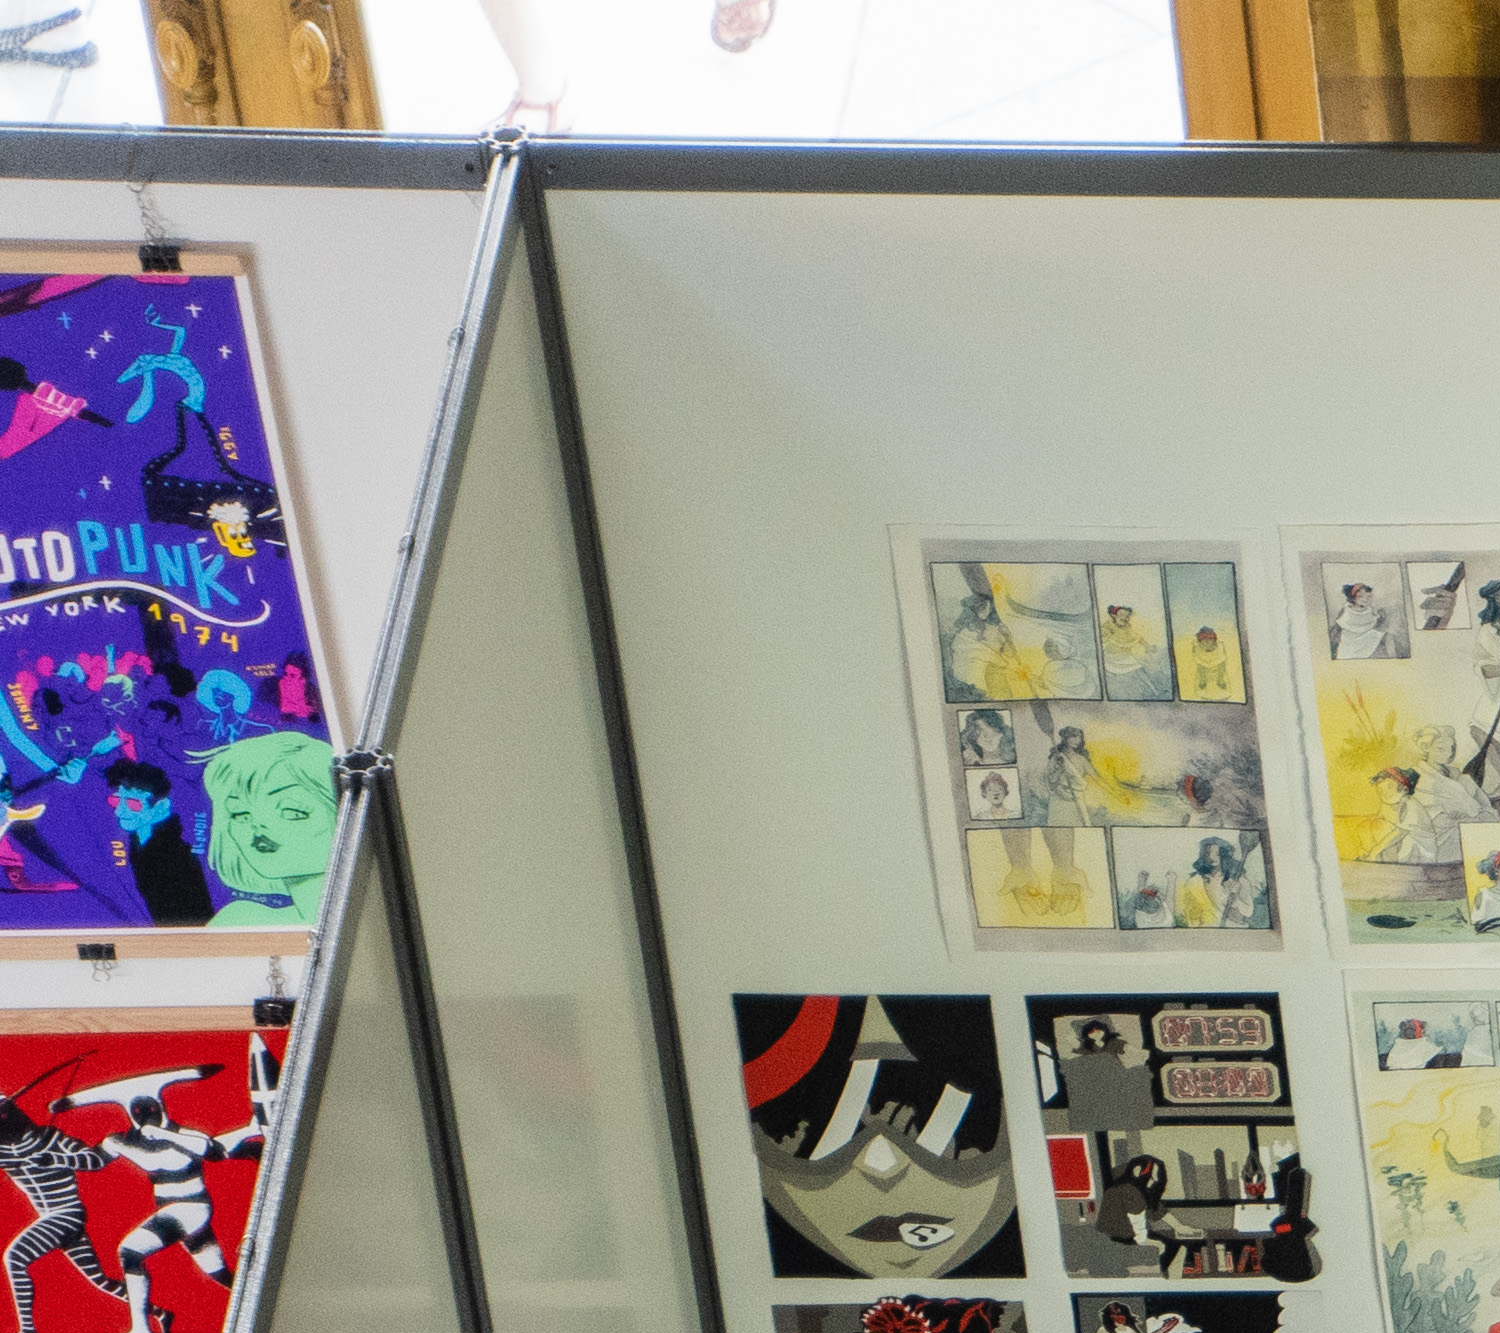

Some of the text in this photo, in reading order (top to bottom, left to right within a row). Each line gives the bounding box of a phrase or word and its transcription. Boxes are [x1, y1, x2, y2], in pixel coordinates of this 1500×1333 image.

[44, 594, 127, 618] YORK
[147, 602, 240, 653] 1974
[110, 839, 128, 868] LOU
